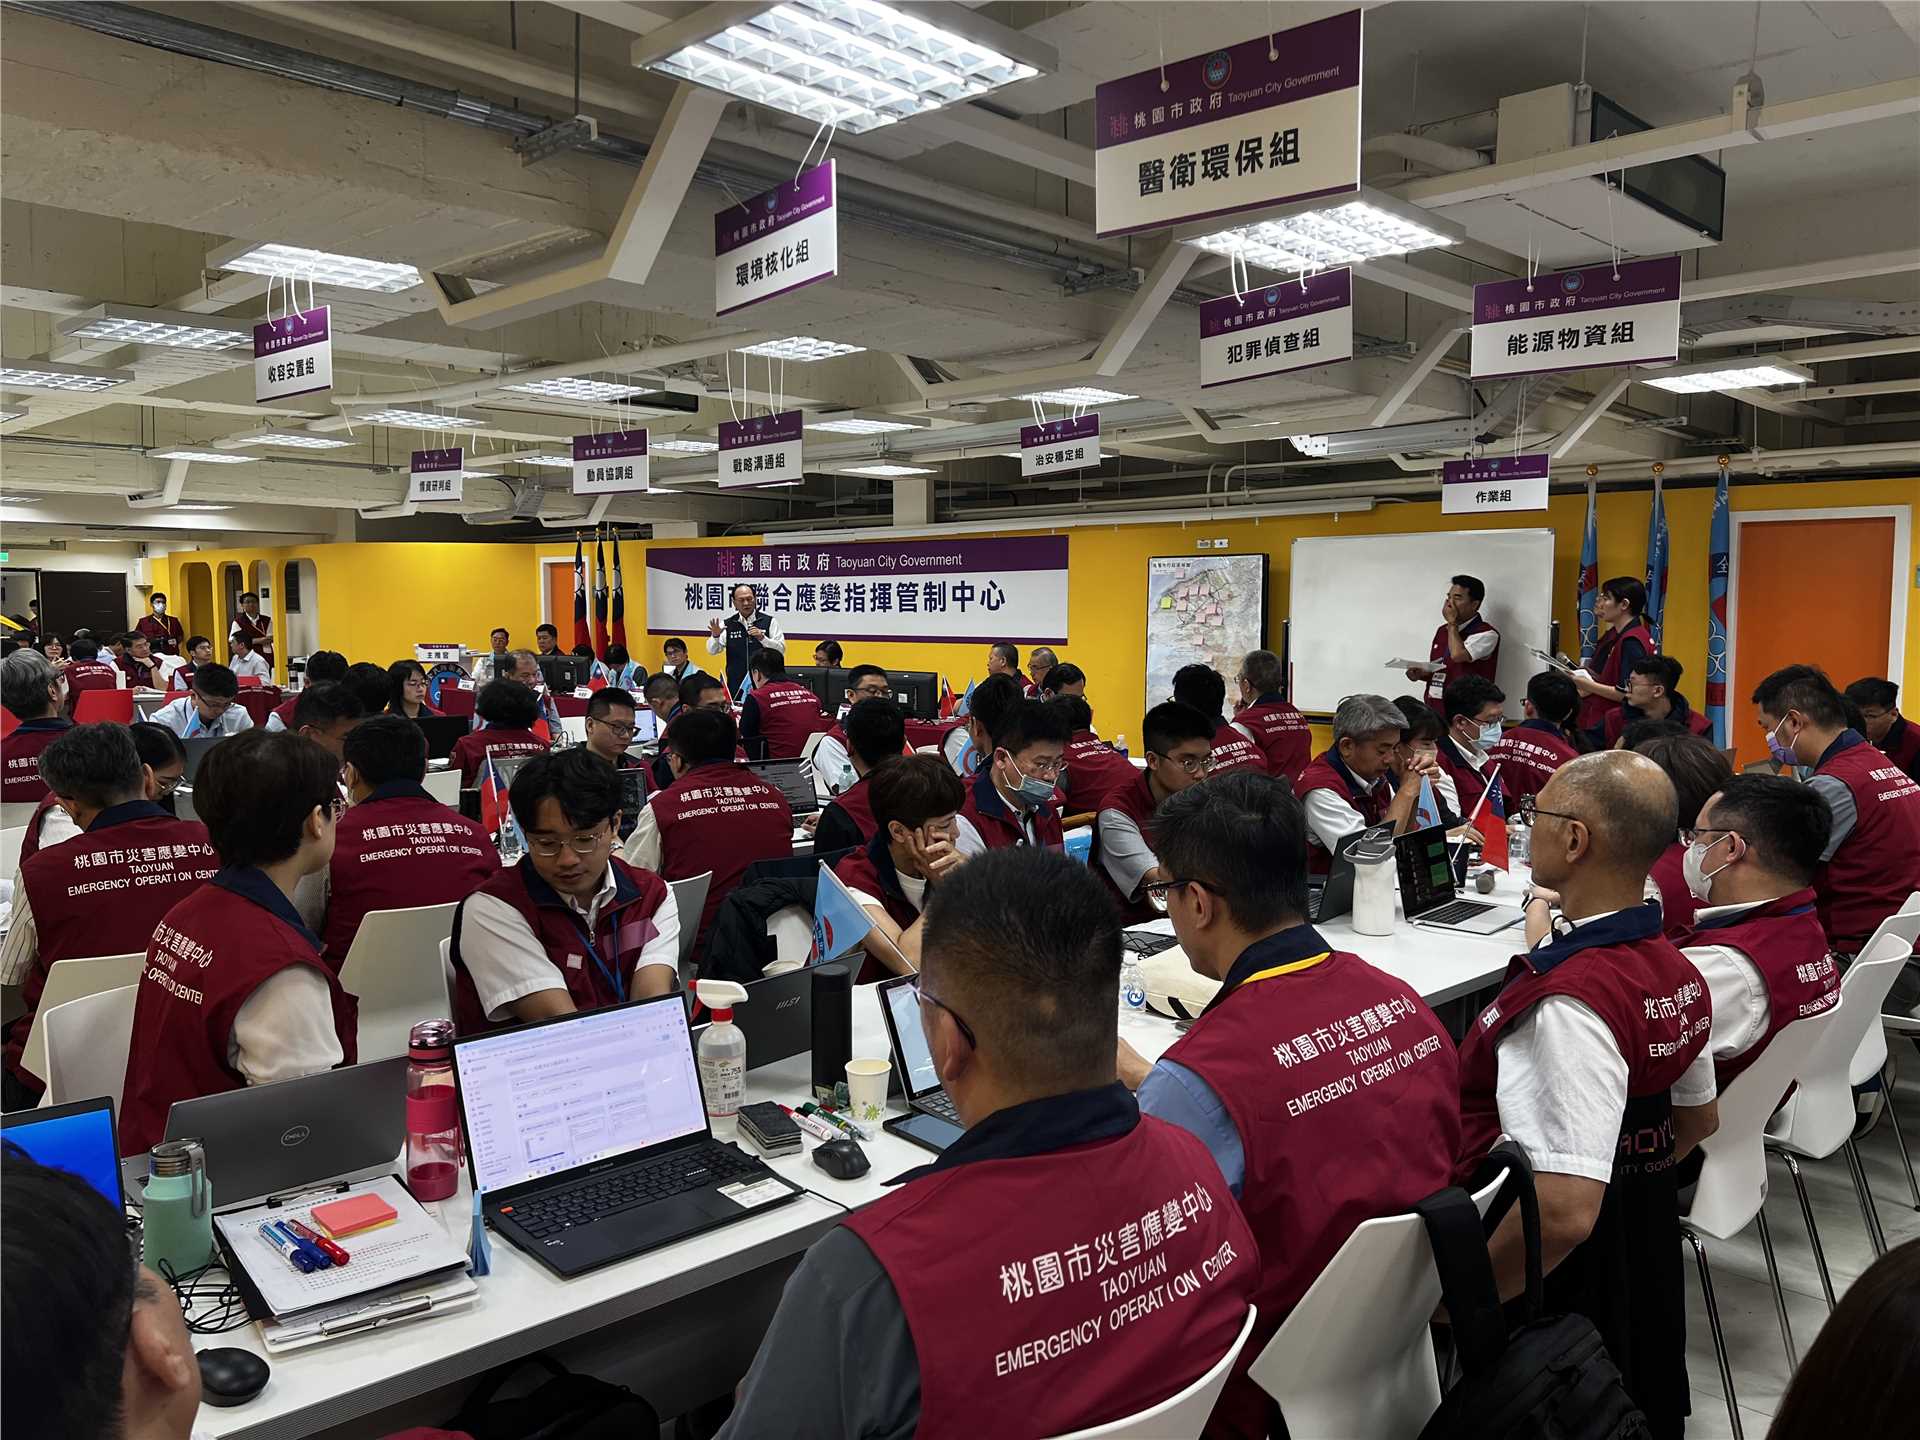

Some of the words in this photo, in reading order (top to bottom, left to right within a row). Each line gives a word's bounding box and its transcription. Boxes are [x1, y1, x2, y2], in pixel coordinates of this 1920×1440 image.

[1134, 92, 1223, 129] 桃園市政府
[1228, 88, 1263, 105] Taoyuan
[1265, 82, 1282, 97] City
[1284, 66, 1340, 89] Government
[1138, 128, 1301, 197] 醫衛環保組
[733, 214, 775, 241] 桃園市政府
[736, 238, 809, 288] 環境核化組
[1504, 296, 1576, 315] 桃園市政府
[1581, 295, 1608, 304] Taoyuan
[1609, 292, 1622, 301] City
[1623, 287, 1666, 299] Government
[1223, 307, 1276, 328] 桃園市政府
[1227, 327, 1320, 365] 犯罪偵查組
[1507, 320, 1635, 357] 能源物資組
[268, 357, 315, 384] 收容安置組
[732, 452, 785, 473] 戰略溝通組
[1035, 447, 1084, 466] 治安穩定組
[586, 466, 633, 482] 動員協調組
[1475, 489, 1512, 504] 作業組
[741, 553, 831, 572] 桃園市政府
[836, 555, 875, 570] Taoyuan
[877, 554, 897, 569] City
[899, 553, 962, 566] Government
[680, 785, 770, 802] 桃園市災害應變中心
[716, 797, 745, 805] TAOYUAN
[677, 806, 718, 820] EMERGENCY
[362, 822, 473, 841] 桃園市災害應變中心
[409, 836, 446, 845] TAOYUAN
[73, 843, 215, 869] 桃園市災害應變中心
[360, 847, 412, 862] EMERGENCY
[129, 862, 174, 874] TAOYUAN
[67, 878, 131, 896] EMERGENCY
[1272, 993, 1417, 1069] 桃園市災害應變中心
[1346, 1035, 1393, 1066] TAOYUAN
[1286, 1073, 1358, 1117] EMERGENCY
[1413, 1035, 1442, 1060] CENTER
[999, 1181, 1213, 1304] 桃園市災害應變中心
[1100, 1252, 1167, 1302] TAOYUAN
[995, 1315, 1102, 1377] EMERGENCY
[1202, 1240, 1238, 1281] CENTER
